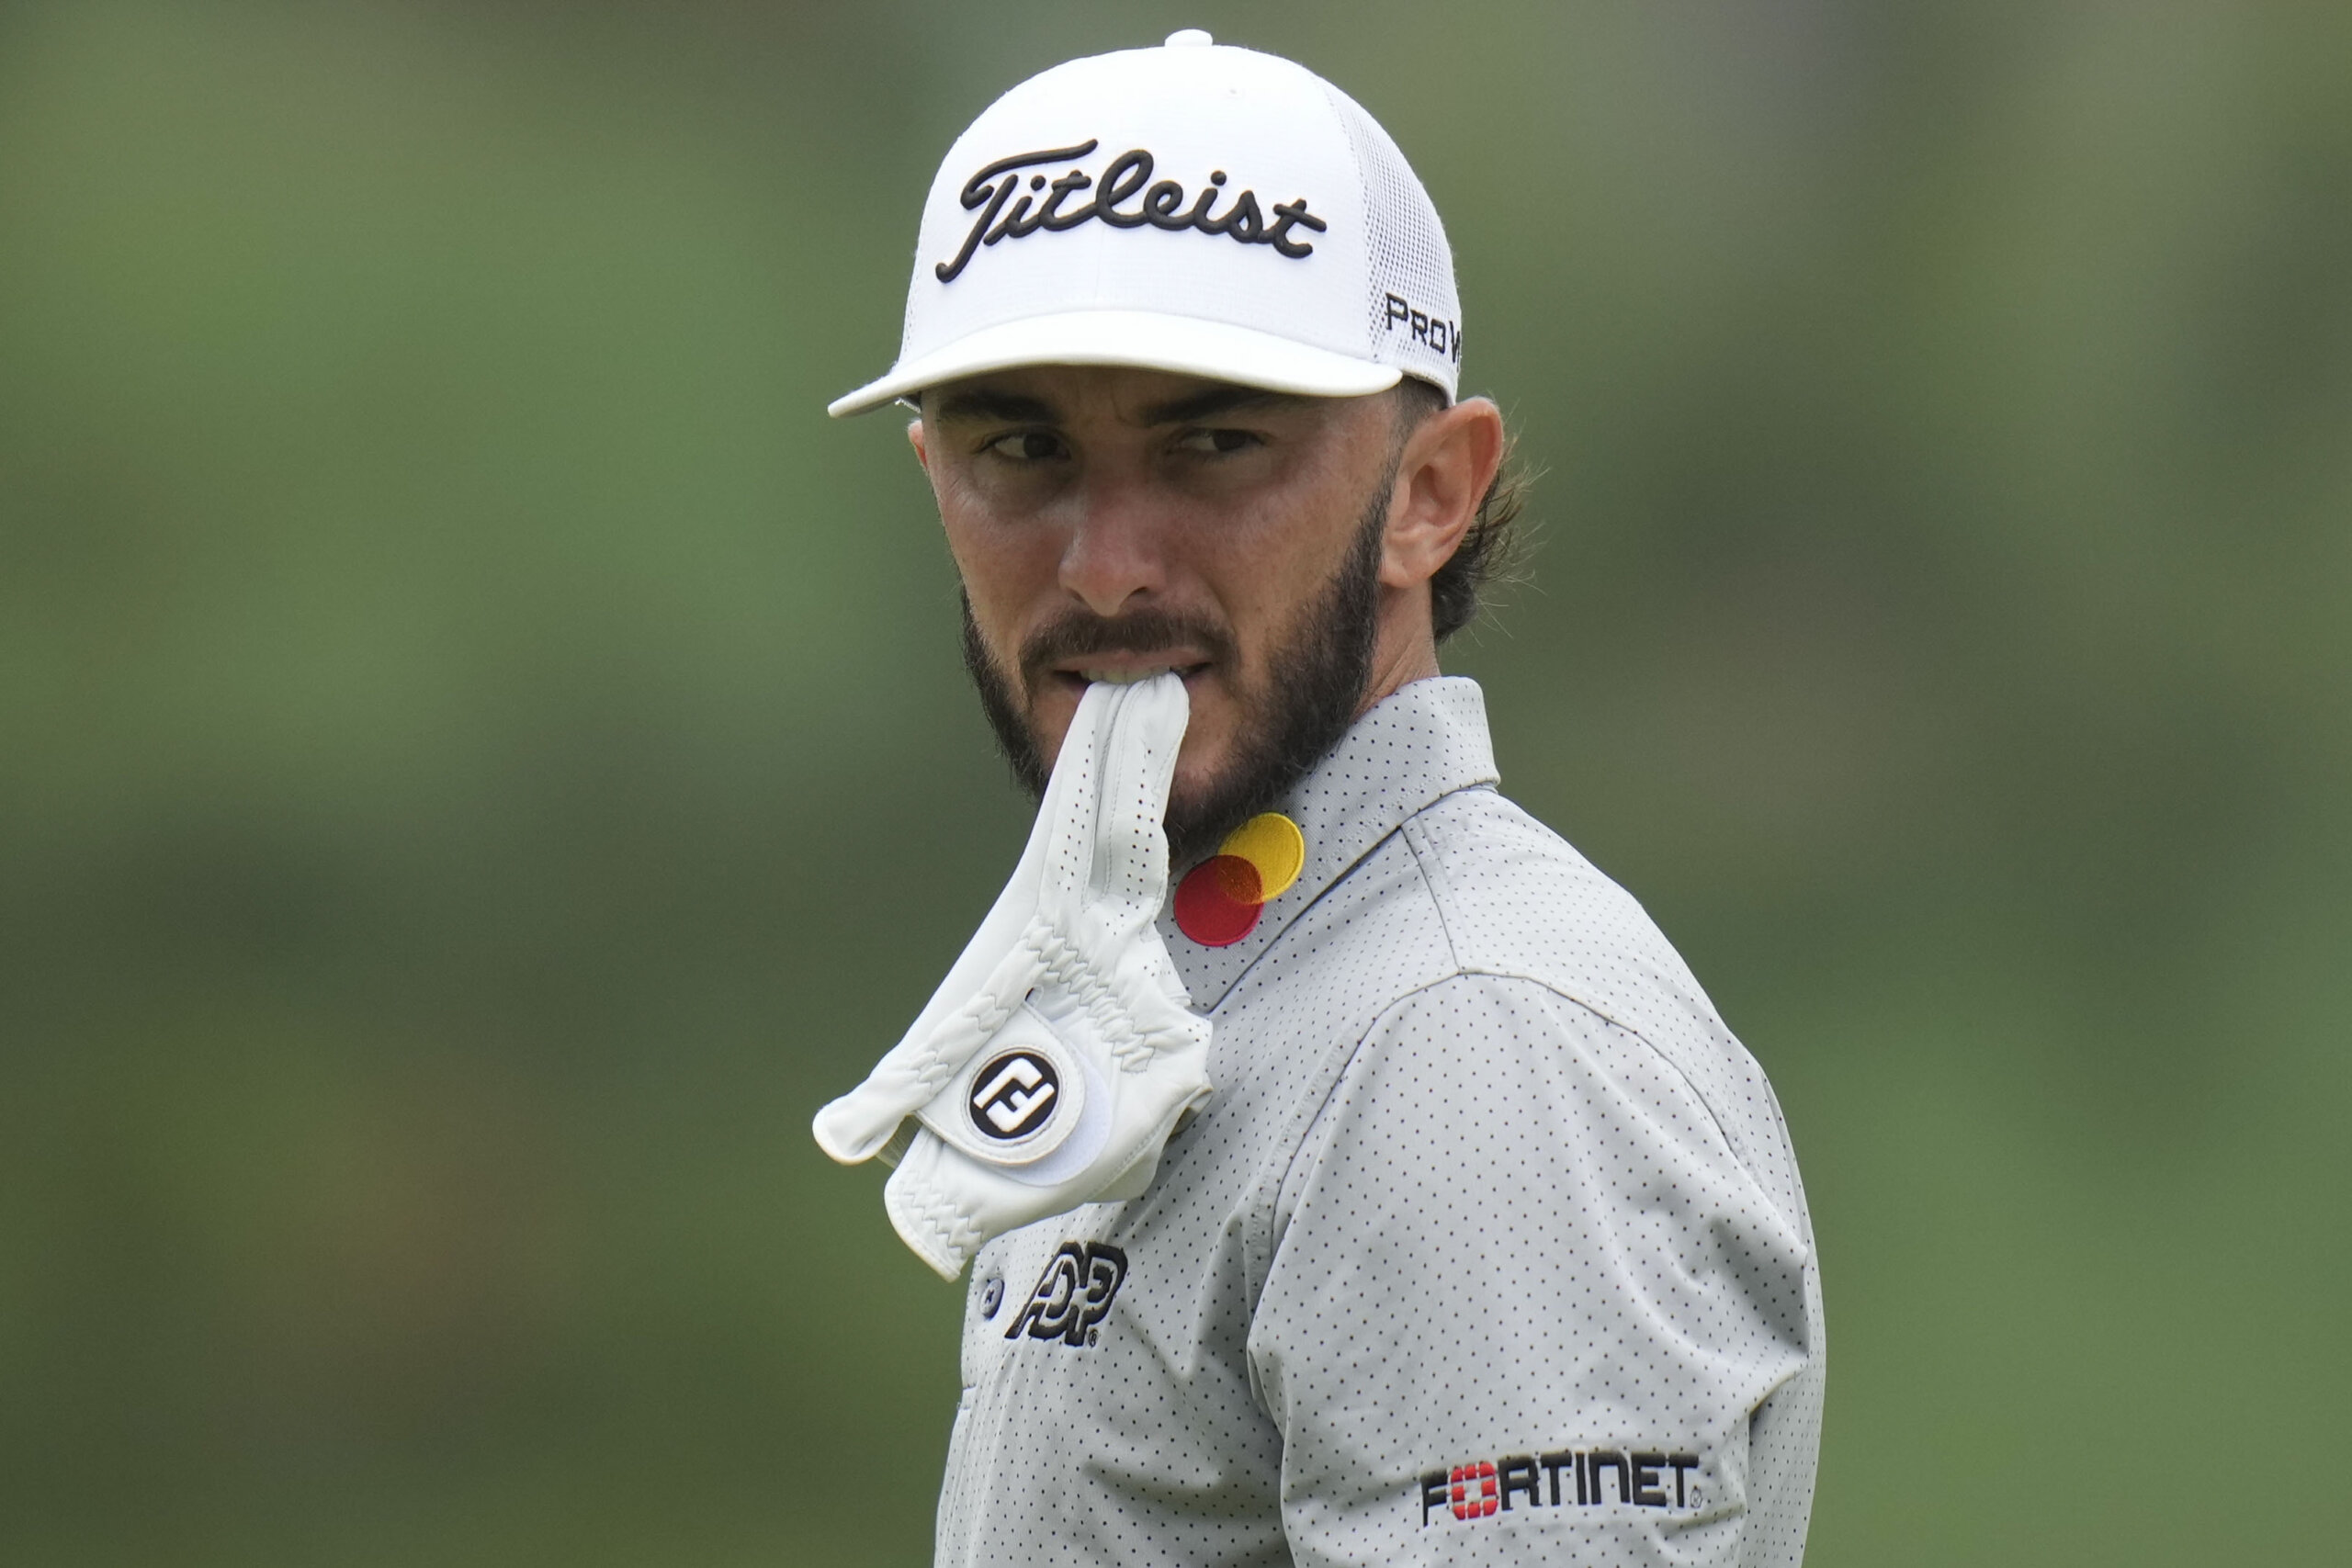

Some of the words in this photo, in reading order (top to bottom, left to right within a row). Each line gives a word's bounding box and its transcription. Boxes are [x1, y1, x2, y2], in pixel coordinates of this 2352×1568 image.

[935, 139, 1327, 283] Titleist
[1004, 1241, 1128, 1347] ADP
[1420, 1450, 1700, 1528] FORTINET
